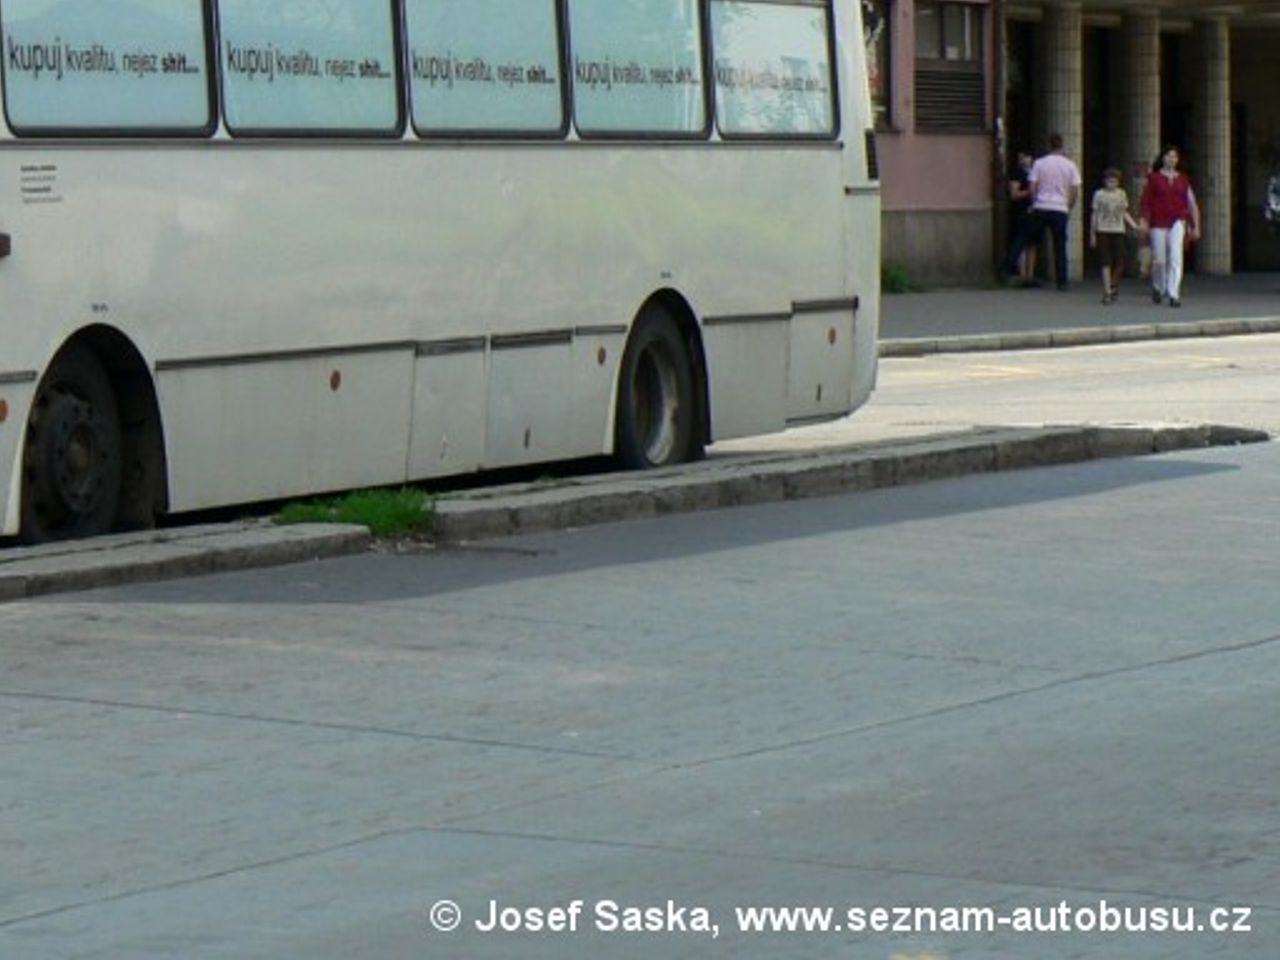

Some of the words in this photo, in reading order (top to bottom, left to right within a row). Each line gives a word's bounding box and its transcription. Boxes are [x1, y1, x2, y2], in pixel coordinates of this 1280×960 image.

[9, 35, 62, 80] kupuj
[122, 50, 158, 77] nejez
[226, 40, 273, 82] kupuj
[412, 49, 453, 88] kupuj
